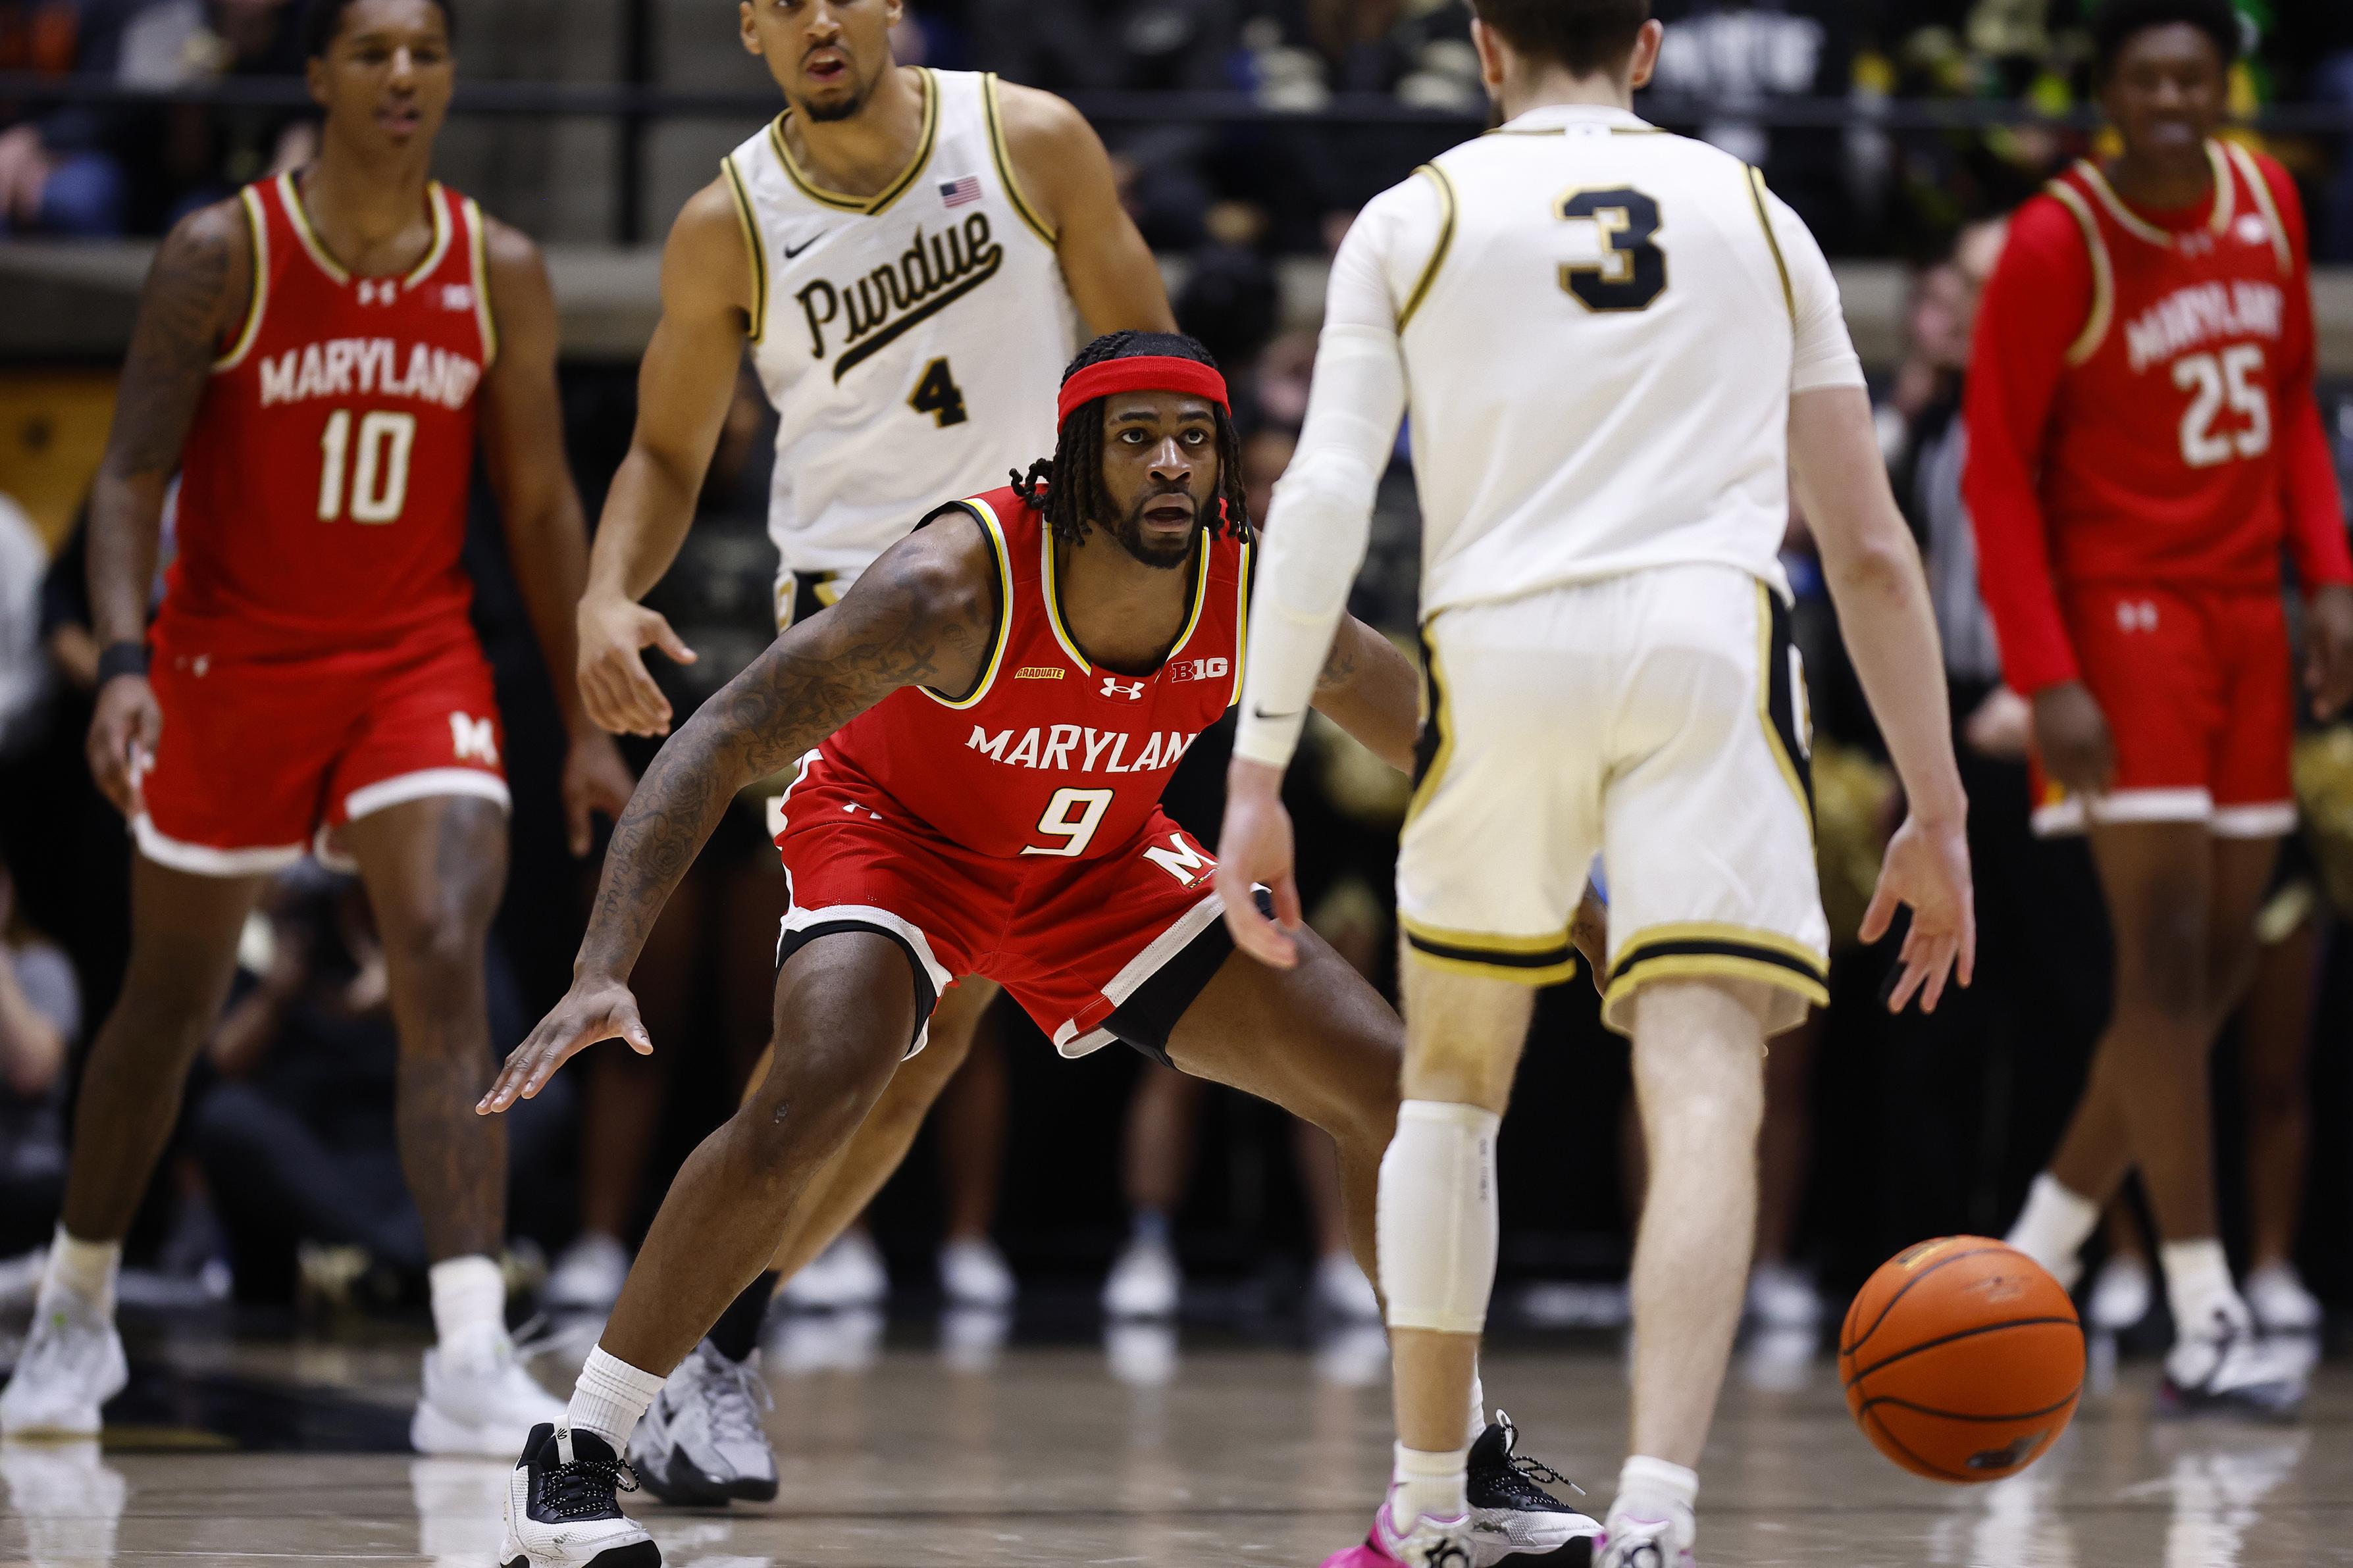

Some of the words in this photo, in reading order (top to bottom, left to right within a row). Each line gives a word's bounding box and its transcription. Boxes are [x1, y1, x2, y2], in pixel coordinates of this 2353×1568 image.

[1553, 184, 1668, 313] 3
[795, 212, 1002, 360] Purdue
[259, 336, 481, 411] MARYLAND
[906, 355, 968, 428] 4
[2172, 343, 2271, 468] 25
[317, 409, 418, 524] 10
[1016, 667, 1064, 678] GRADUATE
[964, 724, 1201, 772] MARYLAN
[1019, 788, 1114, 857] 9
[1142, 831, 1218, 886] M
